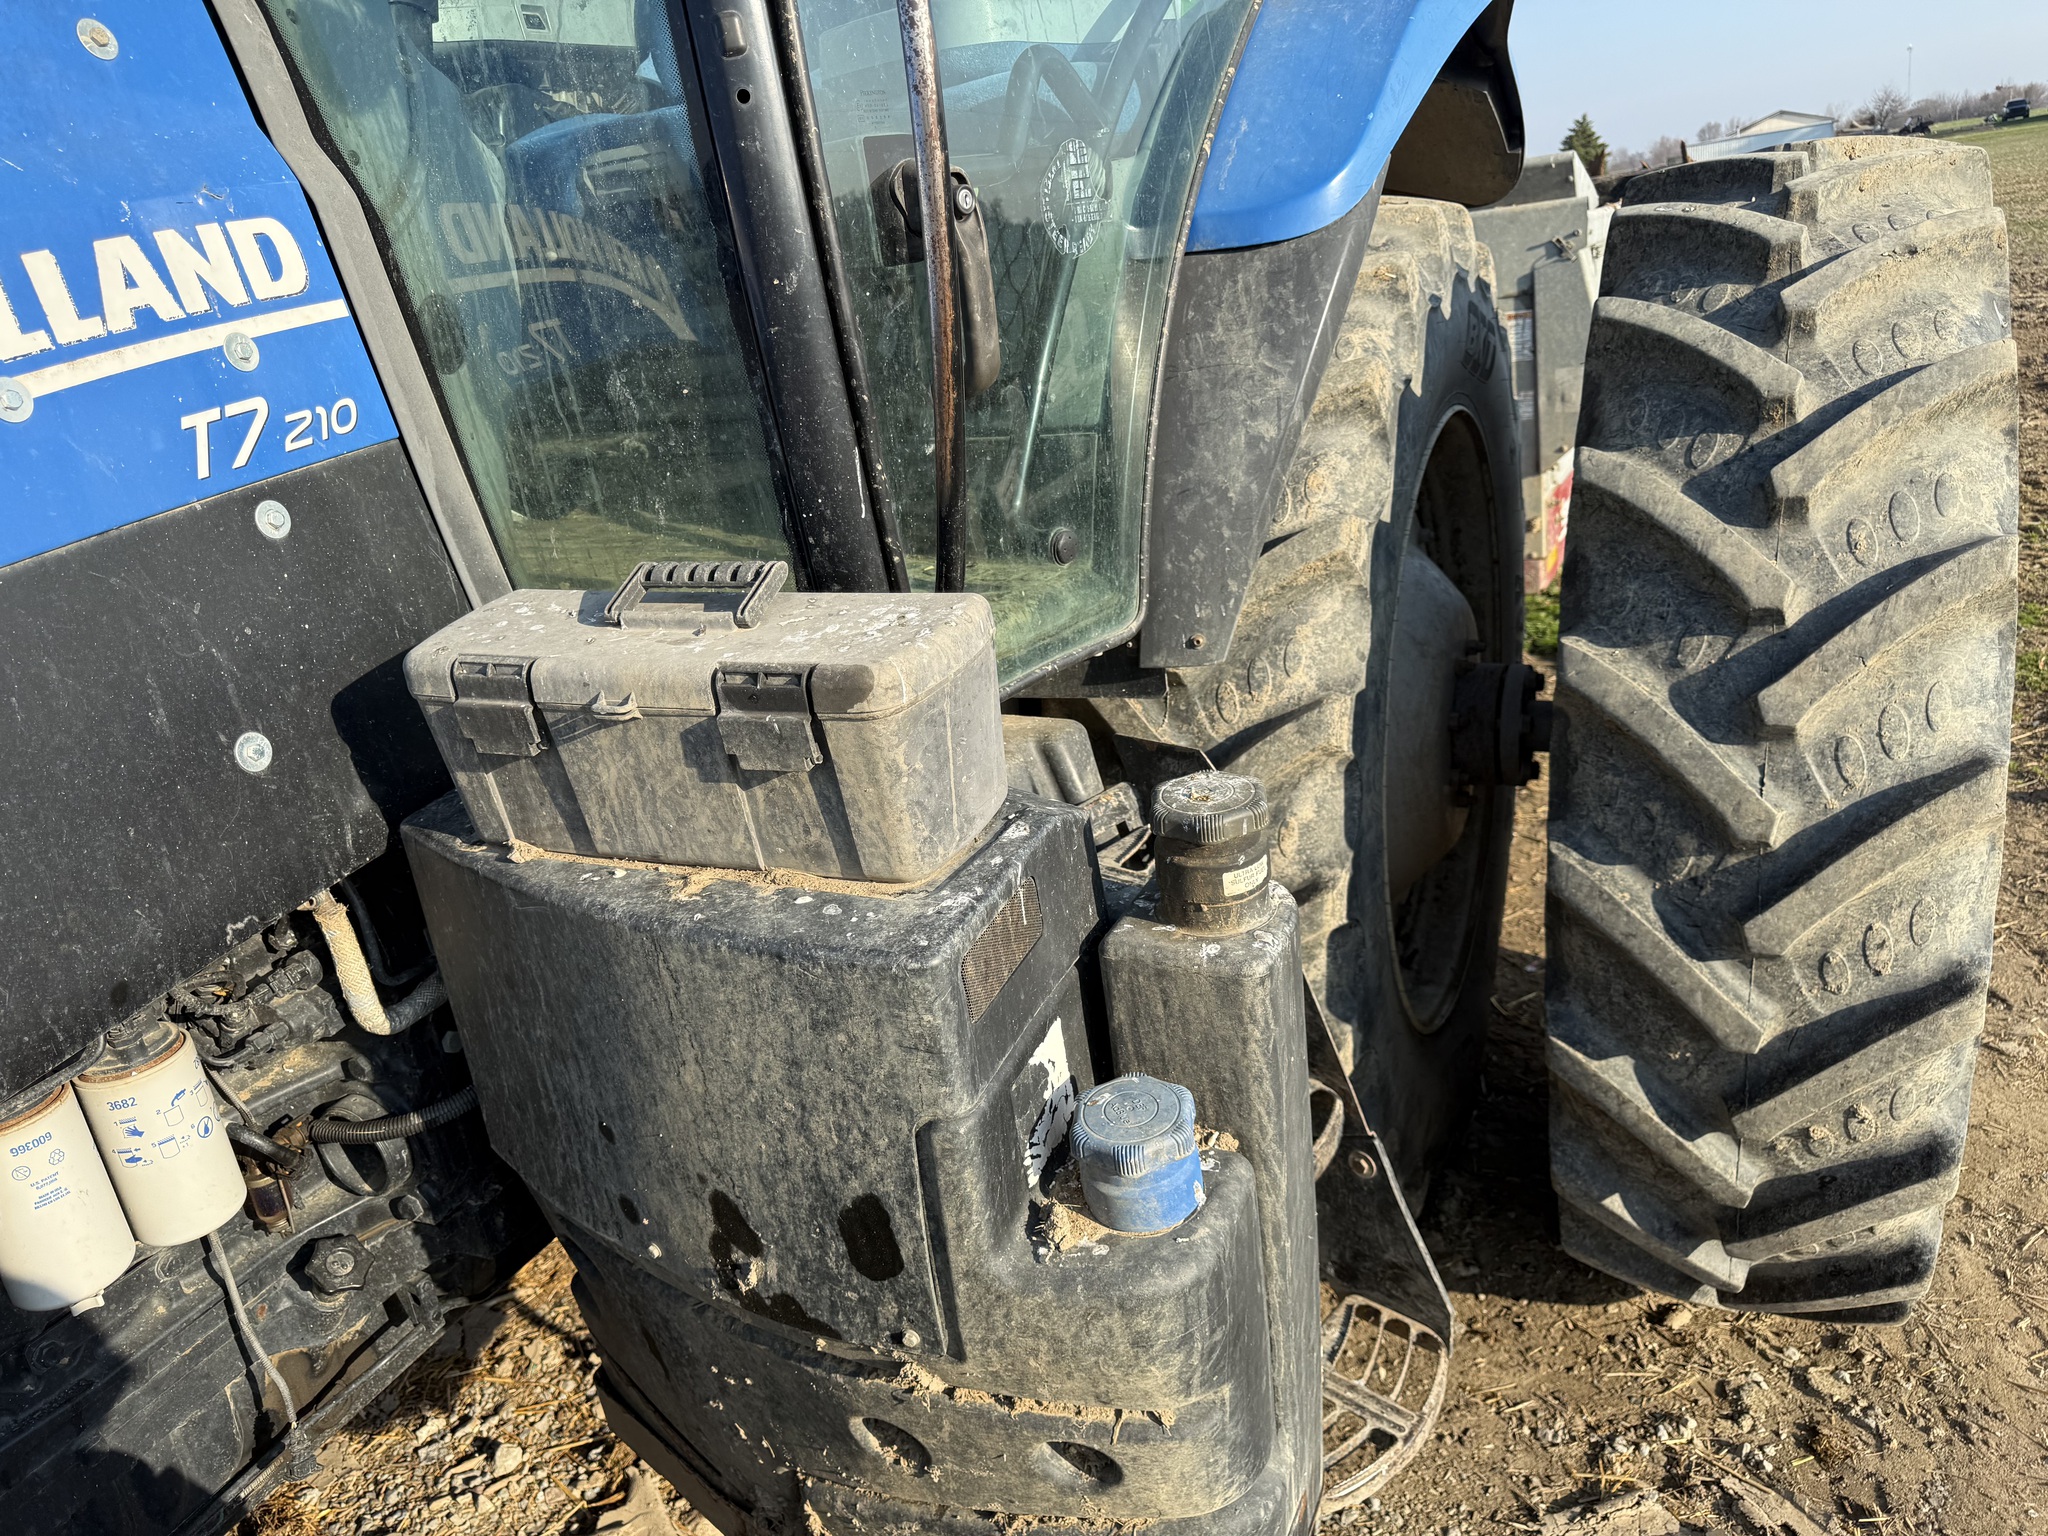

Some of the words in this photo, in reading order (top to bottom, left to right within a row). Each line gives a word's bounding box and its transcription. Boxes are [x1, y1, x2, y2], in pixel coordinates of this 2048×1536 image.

[284, 397, 358, 452] 210
[181, 396, 270, 481] T7
[1234, 868, 1253, 878] ULTRA
[106, 1096, 138, 1112] 3682
[9, 1131, 52, 1158] 600366
